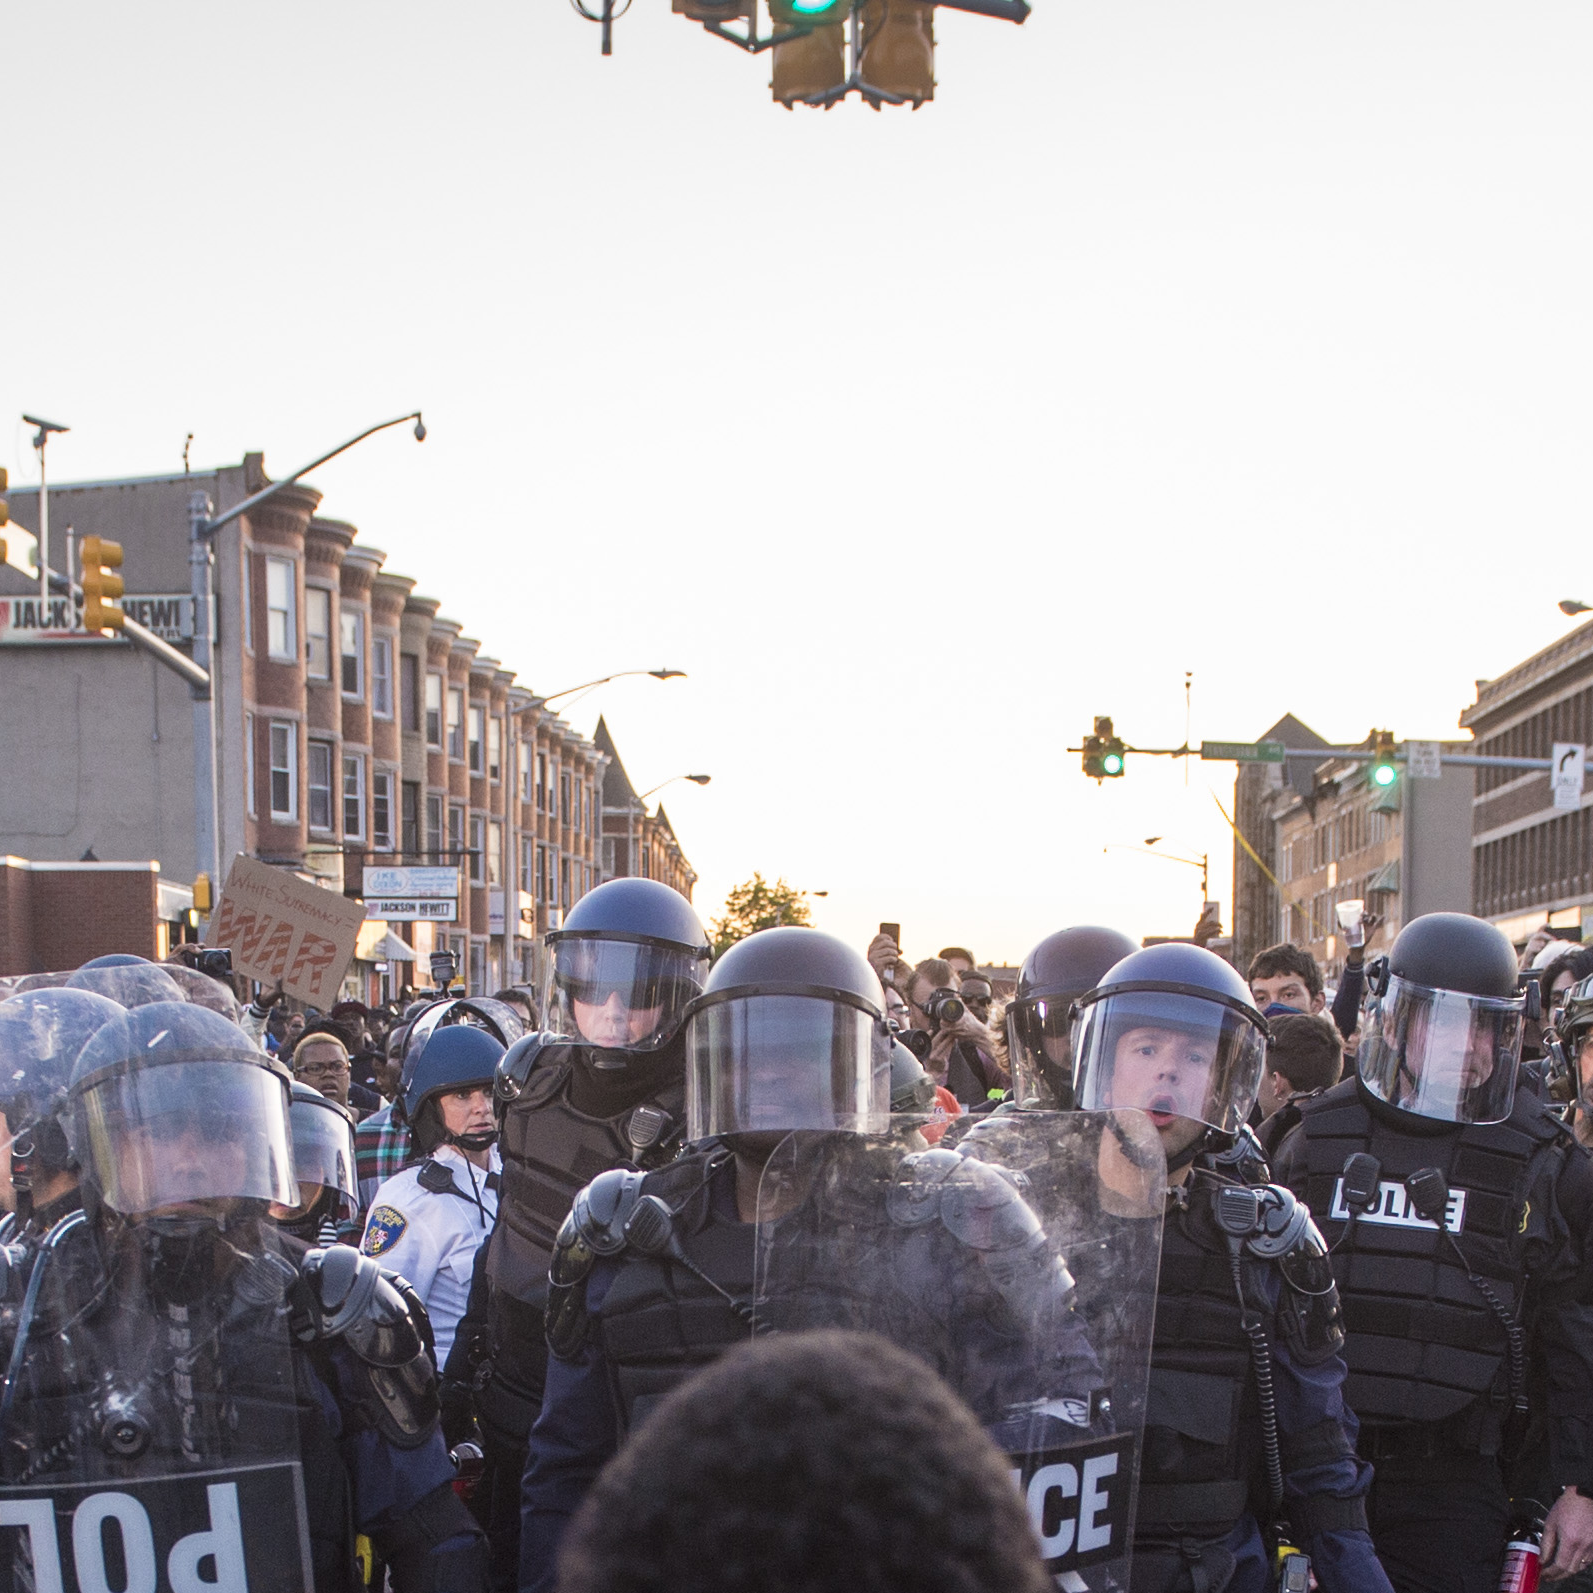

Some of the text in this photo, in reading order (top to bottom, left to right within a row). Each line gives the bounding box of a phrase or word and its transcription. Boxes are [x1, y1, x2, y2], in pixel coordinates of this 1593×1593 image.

[230, 868, 275, 900] WHITE
[276, 884, 342, 926] SUPREMACY
[380, 902, 450, 912] JACKSON HEWITT
[217, 898, 337, 994] WAR
